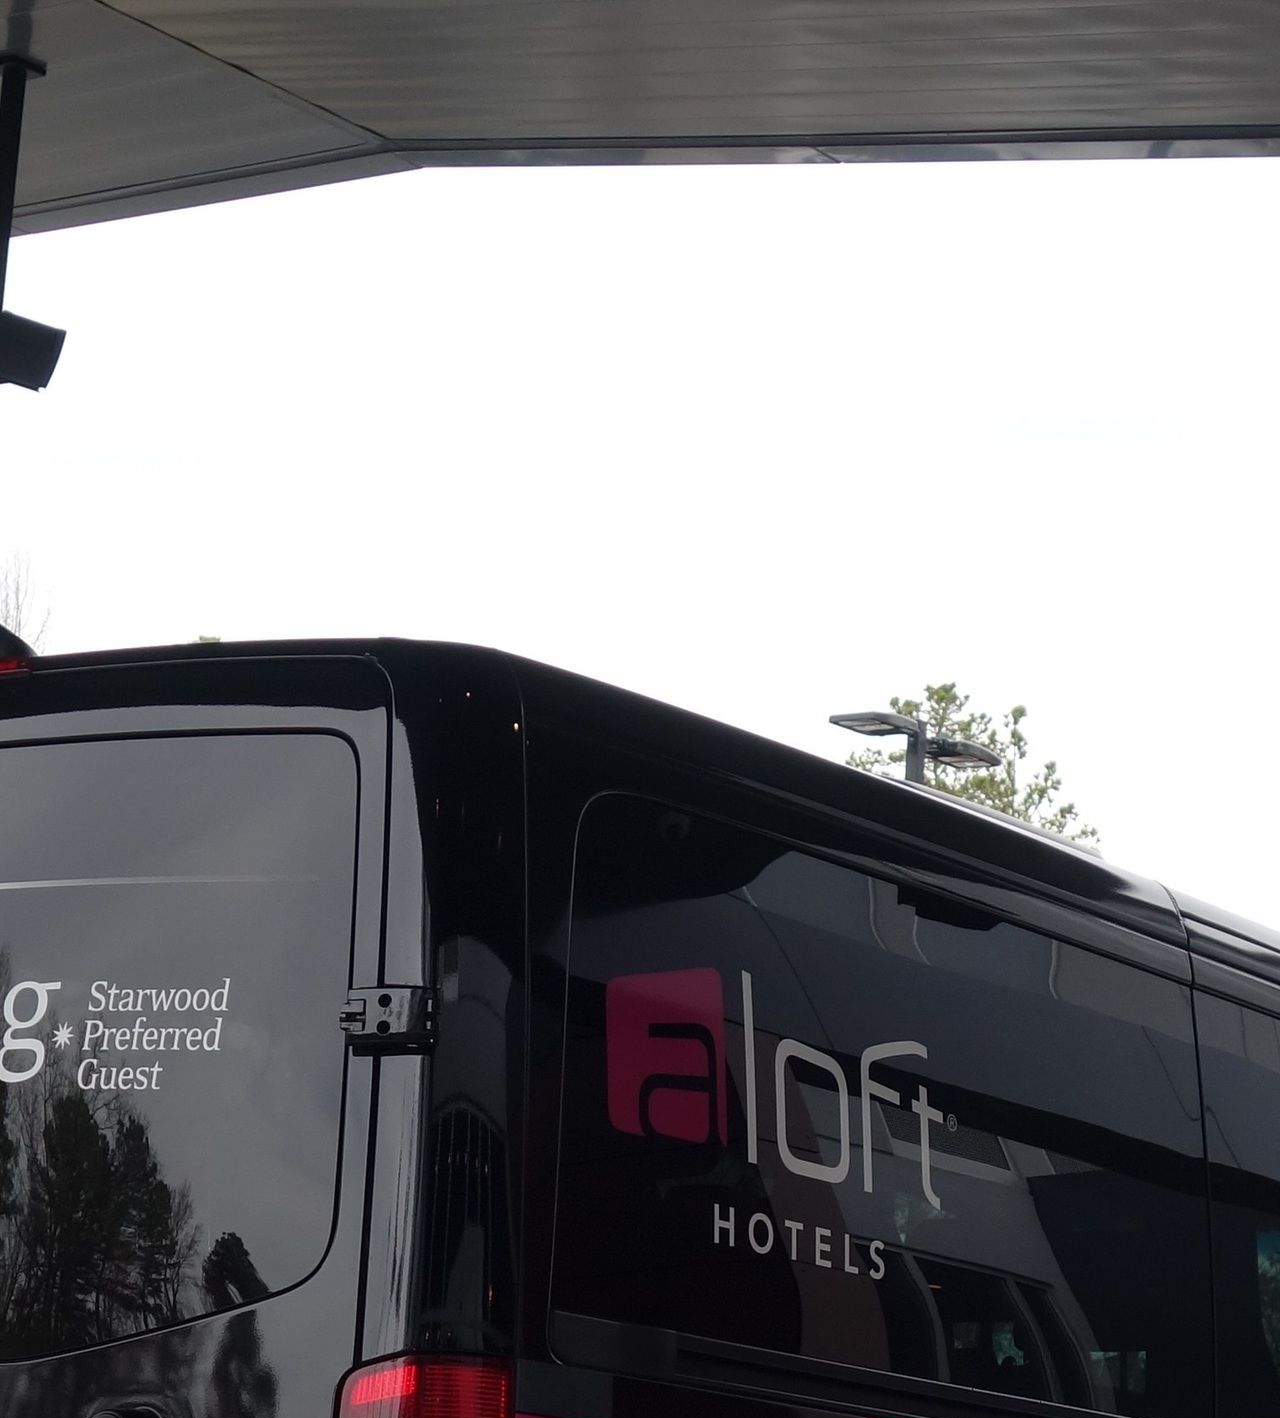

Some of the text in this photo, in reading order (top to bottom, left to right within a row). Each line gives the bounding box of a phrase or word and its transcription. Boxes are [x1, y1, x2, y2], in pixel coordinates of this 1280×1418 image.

[88, 978, 231, 1012] Starwood
[82, 1017, 223, 1051] Preferred
[77, 1058, 163, 1090] Guest
[606, 967, 943, 1210] aloft
[713, 1203, 886, 1280] HOTELS
